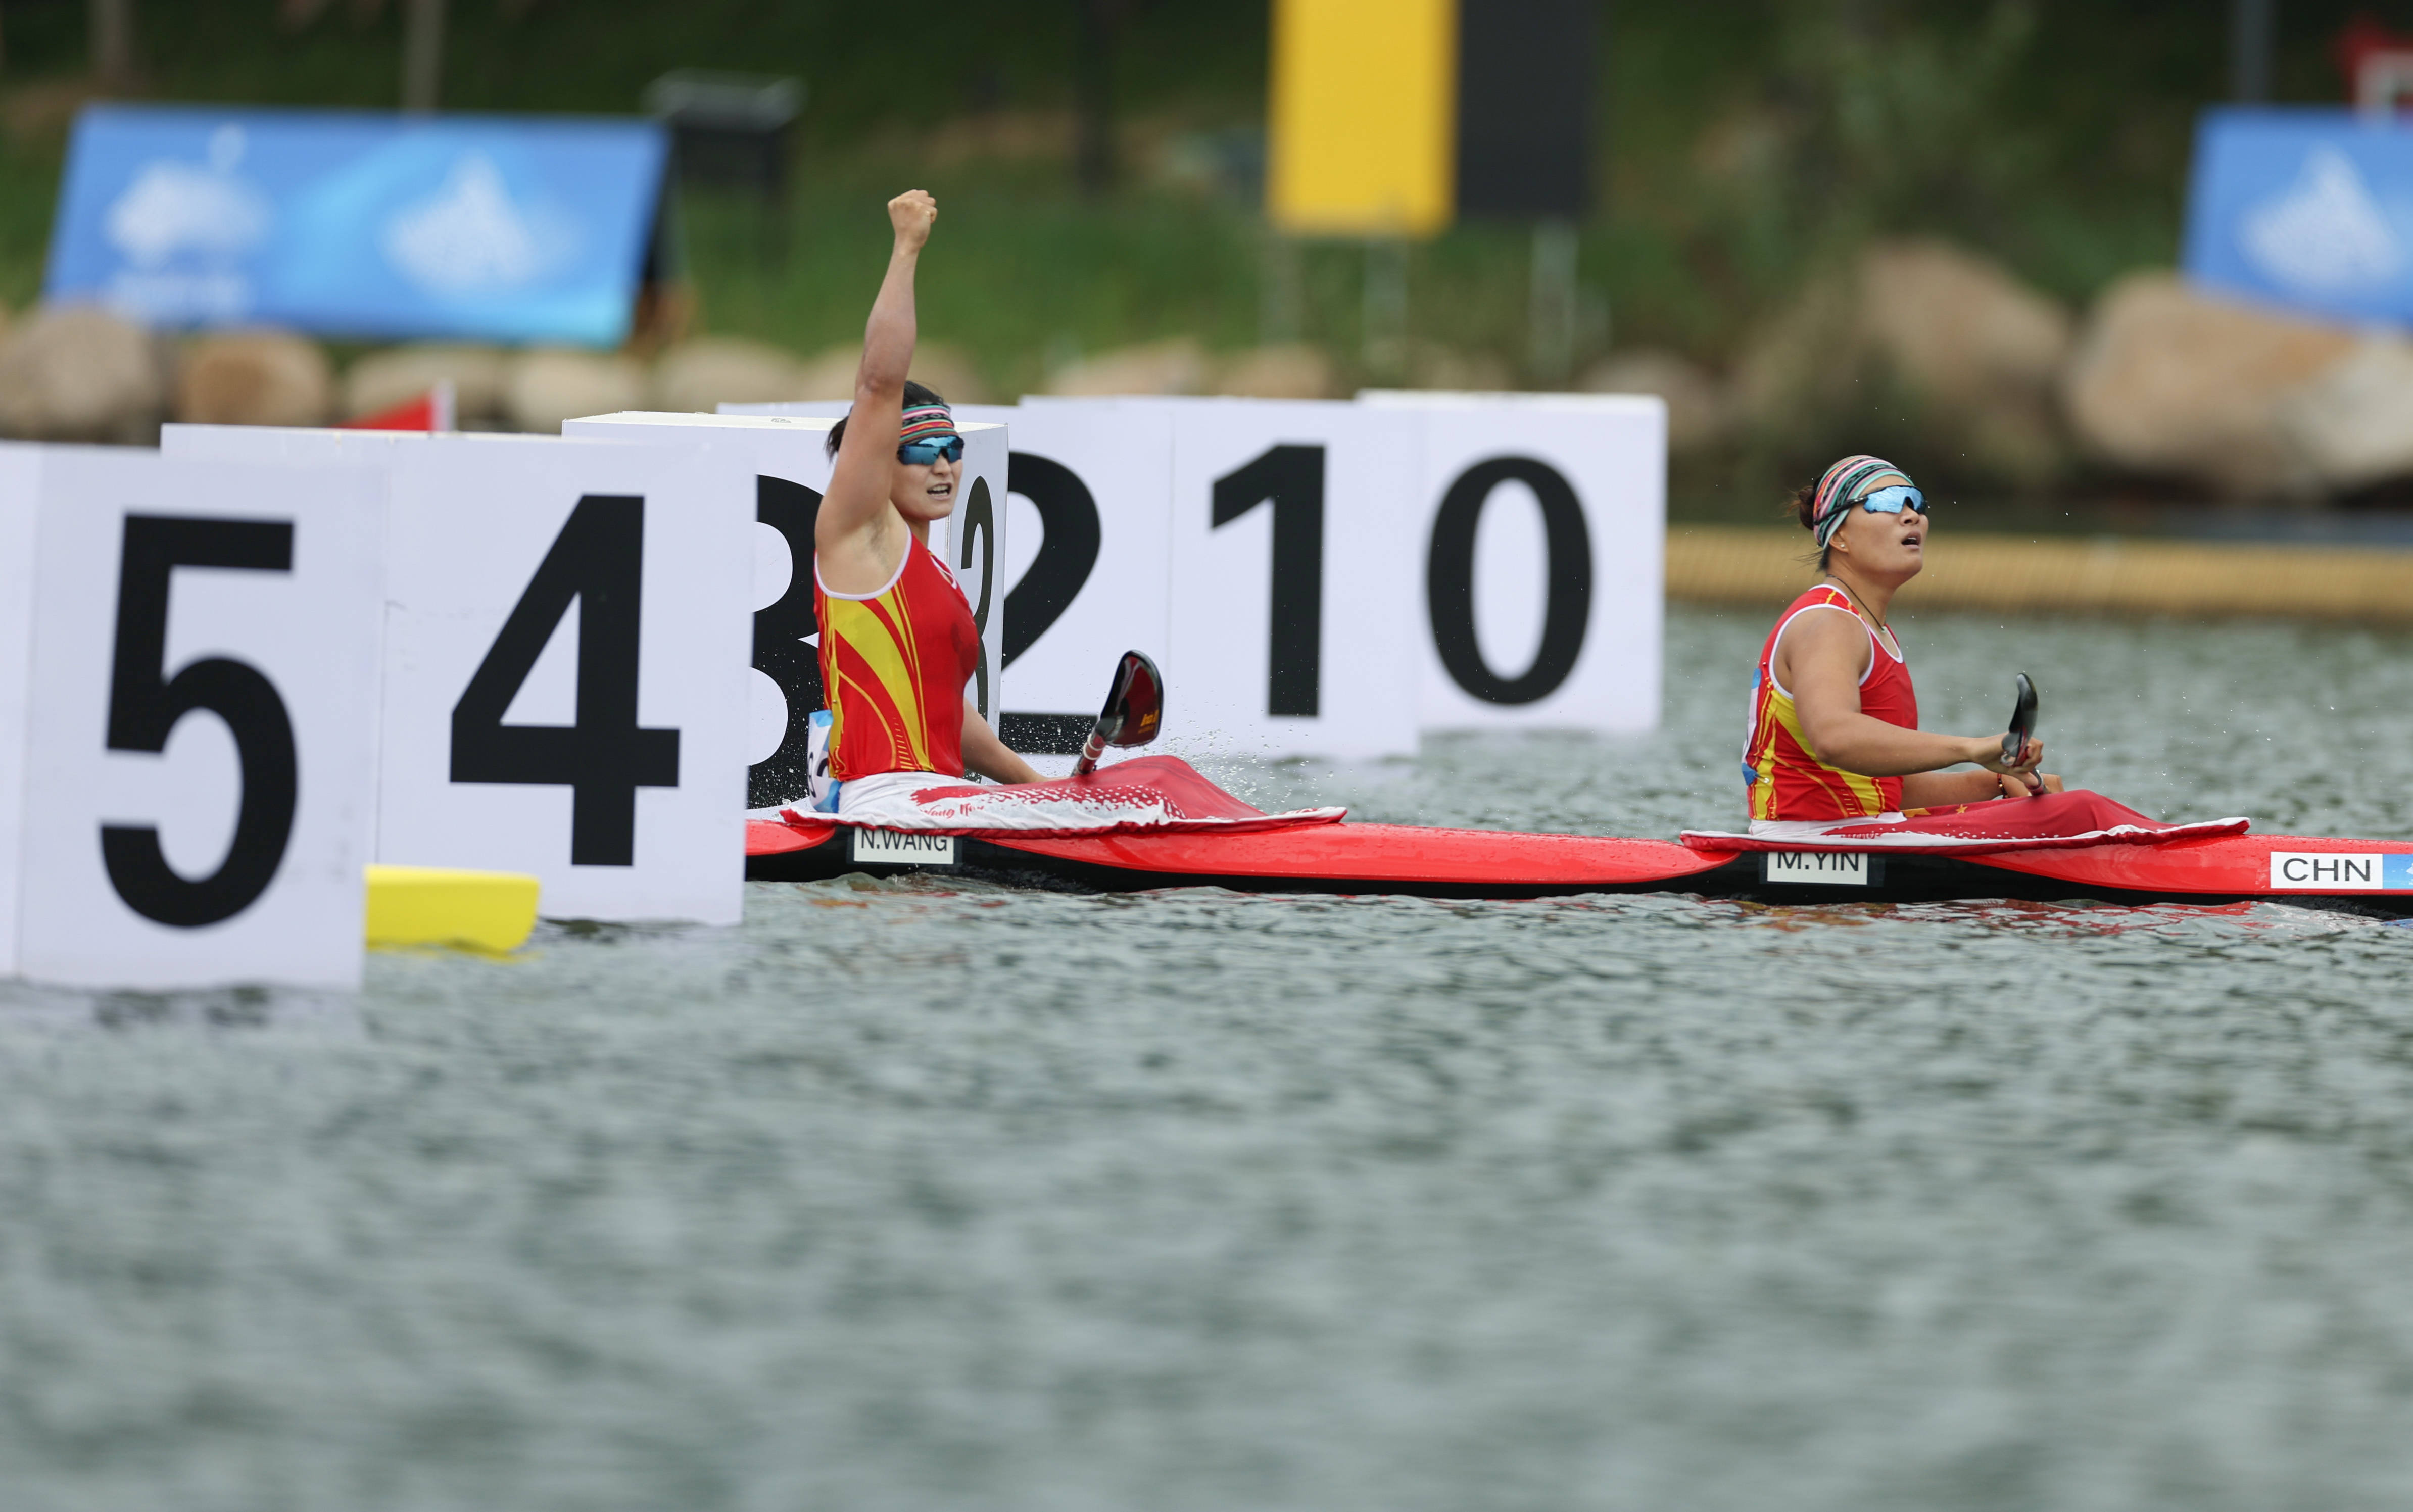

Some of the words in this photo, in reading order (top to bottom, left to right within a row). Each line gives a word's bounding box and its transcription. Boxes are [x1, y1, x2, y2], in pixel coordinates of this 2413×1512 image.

[450, 494, 680, 867] 4
[999, 451, 1101, 755] 2
[1212, 444, 1325, 718] 1
[1426, 455, 1592, 707] 0
[99, 514, 298, 929] 5
[861, 829, 947, 851] N.WANG
[1777, 852, 1859, 871] M.YIN
[2283, 858, 2371, 882] CHN
